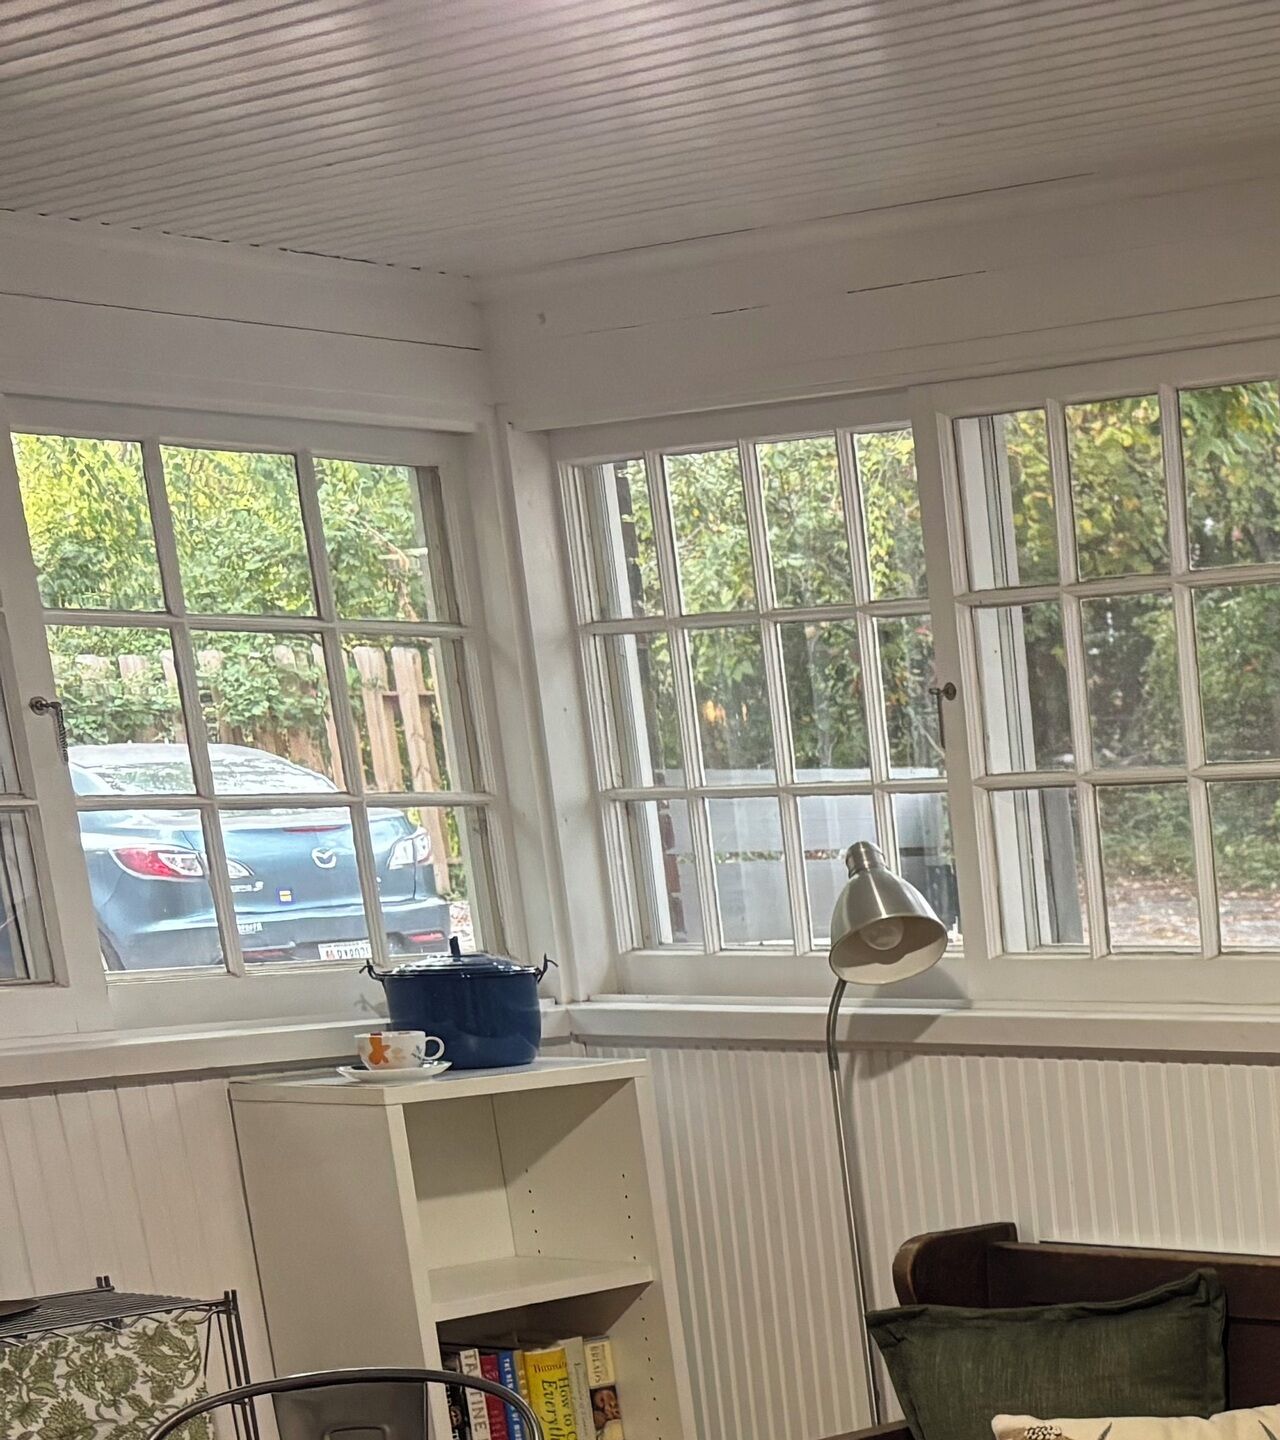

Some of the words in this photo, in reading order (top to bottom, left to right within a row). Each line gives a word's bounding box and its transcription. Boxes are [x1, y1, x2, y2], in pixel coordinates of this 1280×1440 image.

[504, 1358, 512, 1372] THE
[464, 1350, 487, 1432] TATINE
[558, 1377, 570, 1407] How
[563, 1413, 573, 1427] to
